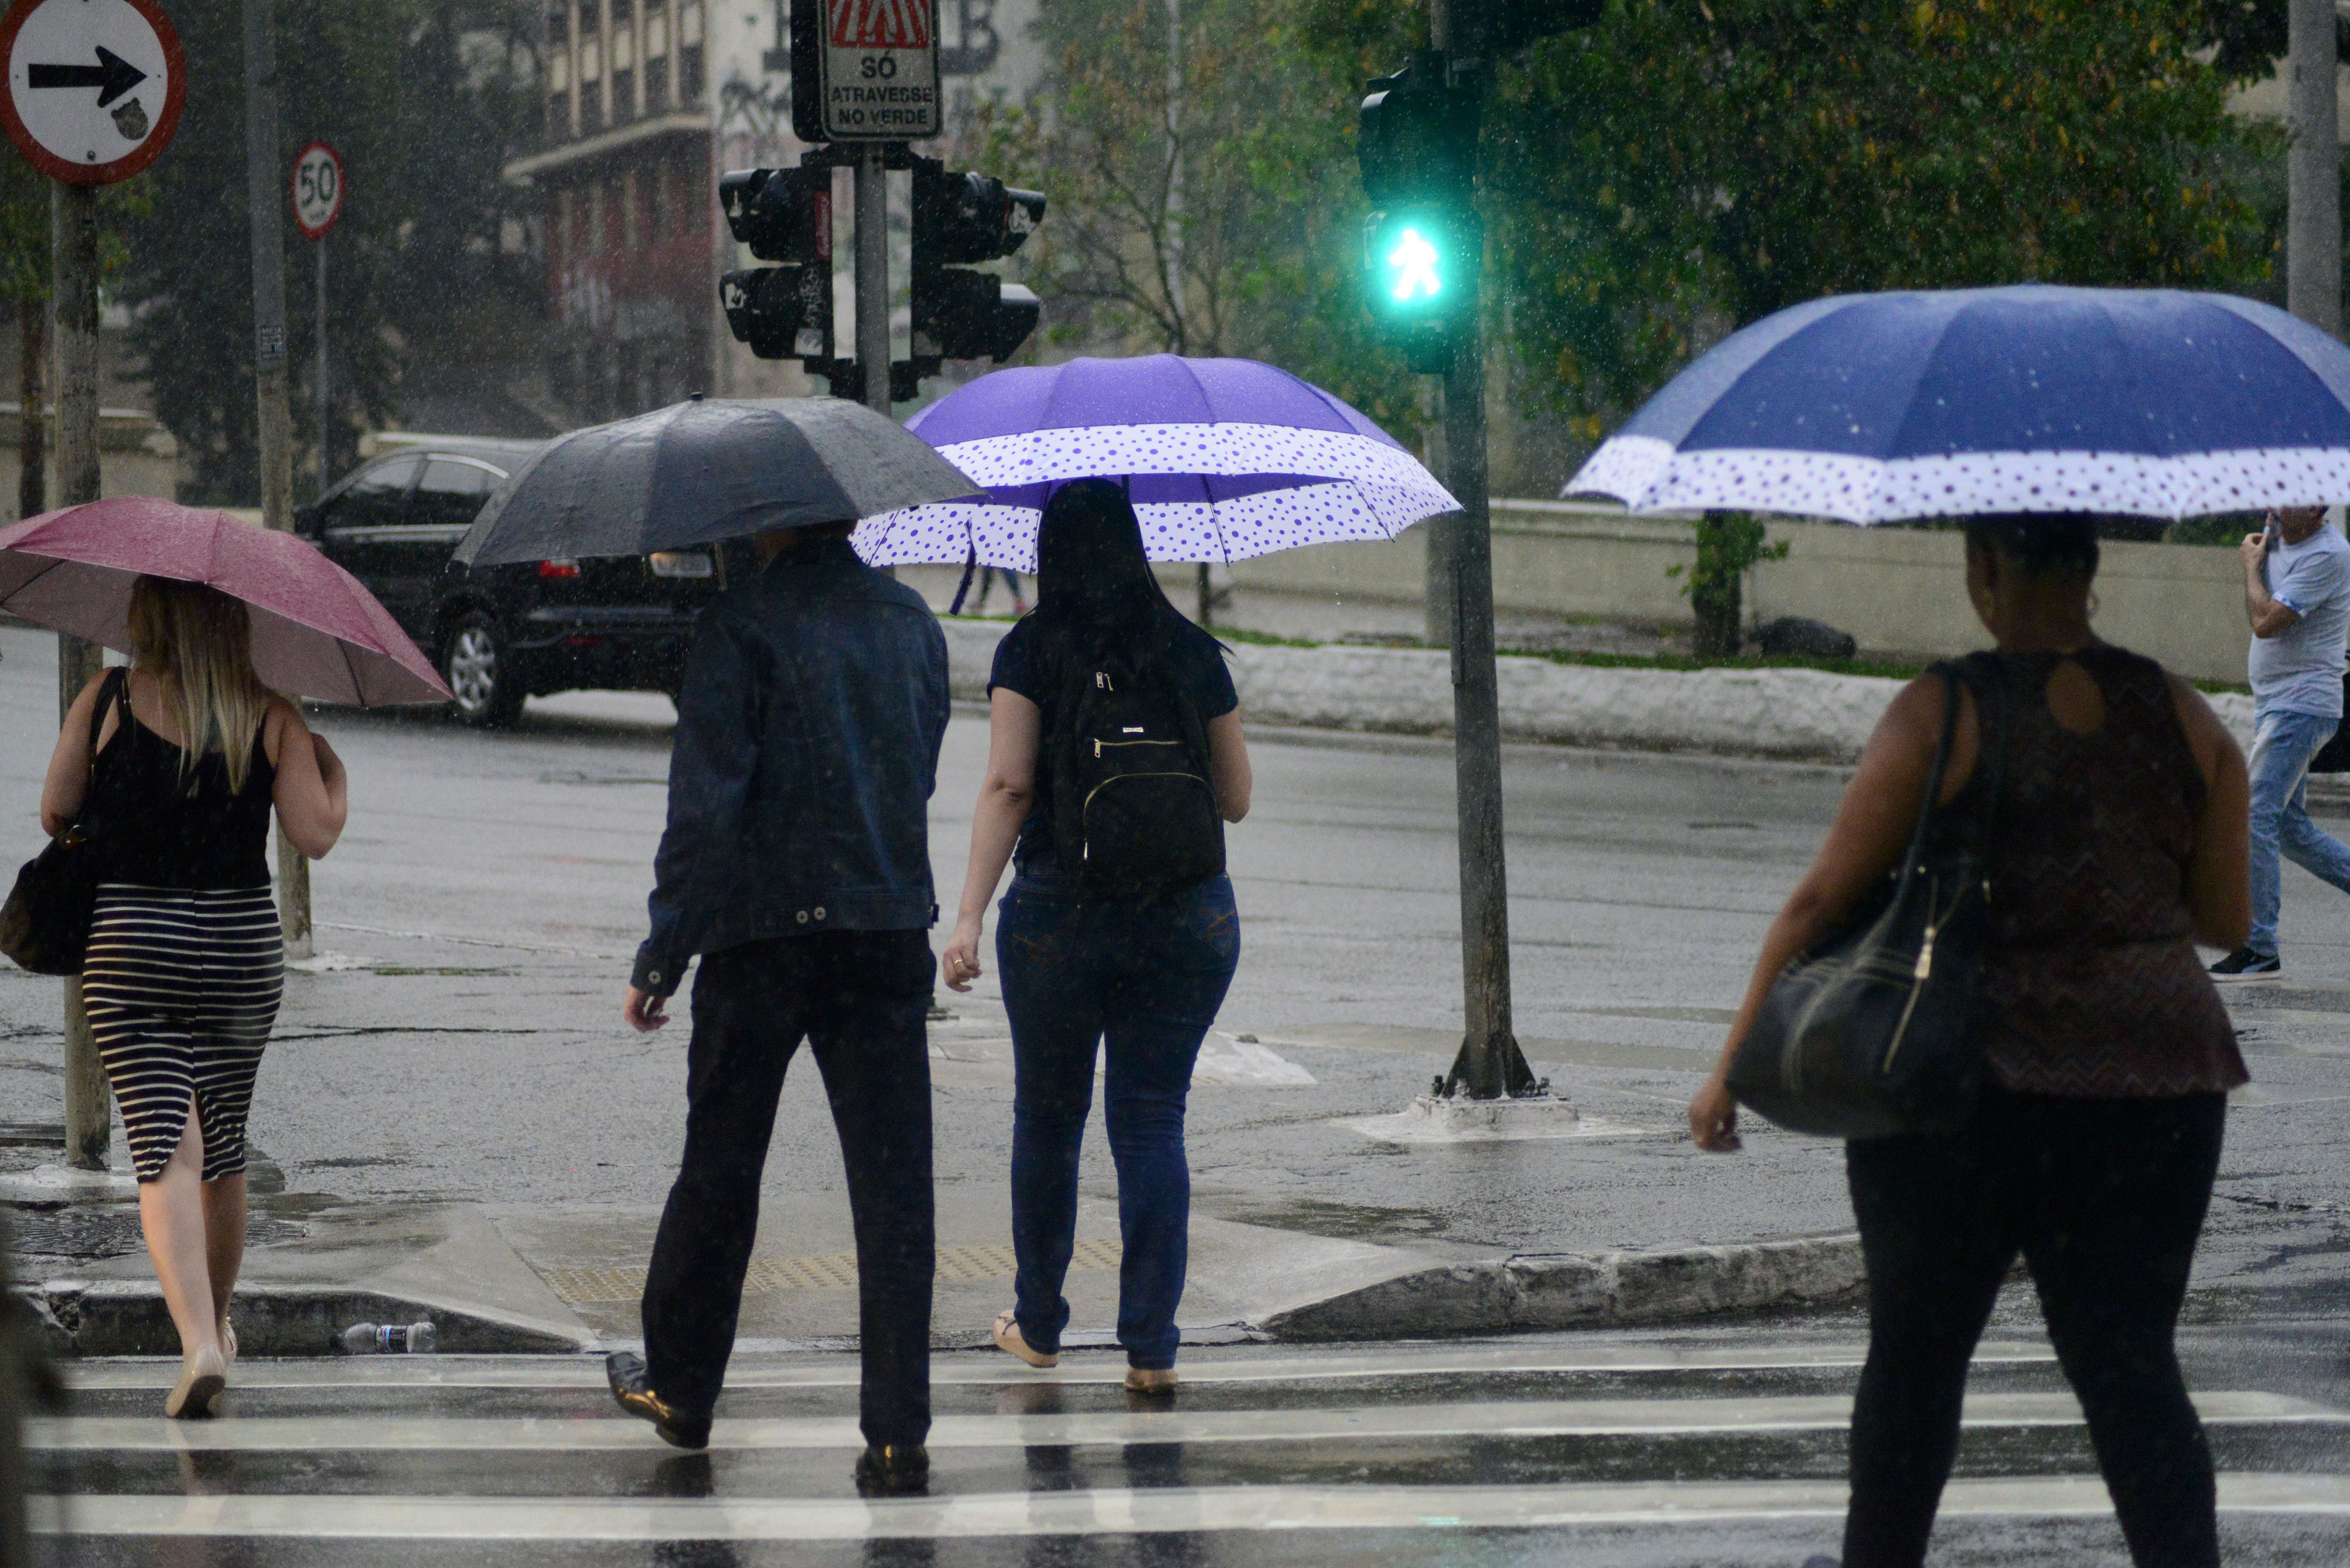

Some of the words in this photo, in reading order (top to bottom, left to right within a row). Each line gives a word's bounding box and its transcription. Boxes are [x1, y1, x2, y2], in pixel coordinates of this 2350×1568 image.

[861, 50, 897, 78] SÓ
[831, 87, 933, 103] ATRAVESSE
[839, 108, 865, 124] NO
[869, 108, 927, 124] VERDE
[301, 160, 335, 206] 50
